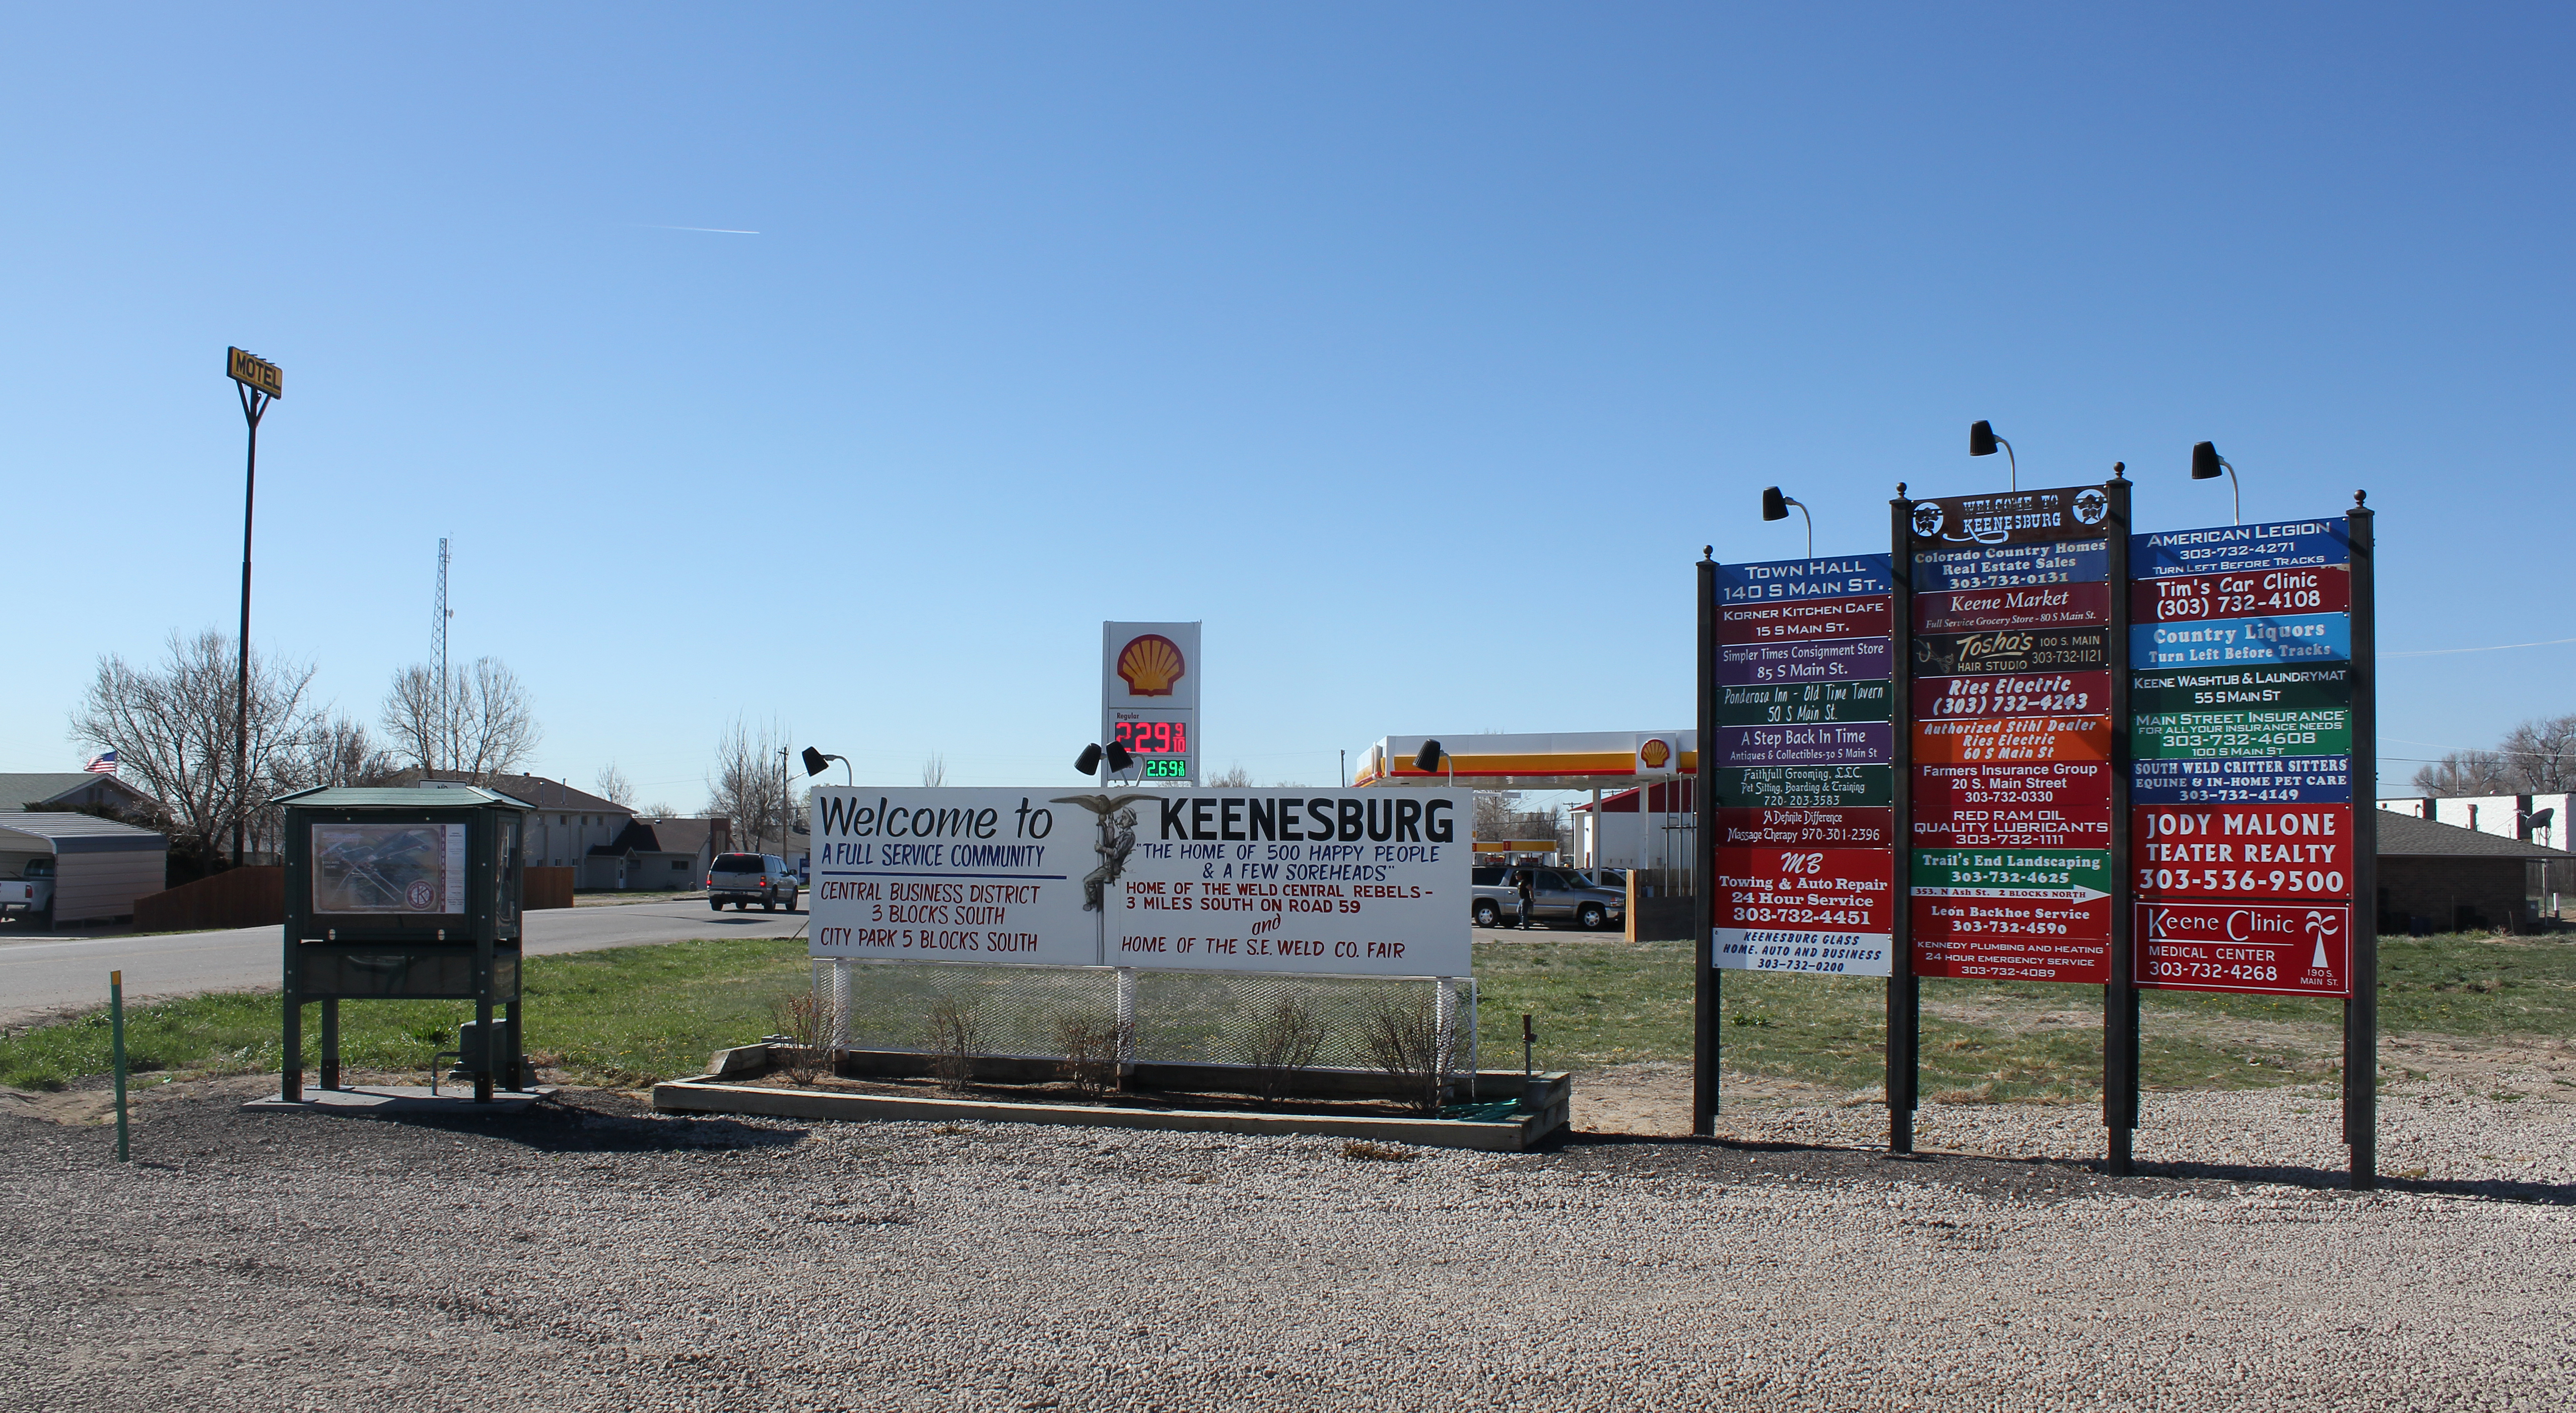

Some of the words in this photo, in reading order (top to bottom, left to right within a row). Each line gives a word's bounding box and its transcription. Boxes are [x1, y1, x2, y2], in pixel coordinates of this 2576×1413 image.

[236, 352, 281, 391] MOTEL
[1962, 496, 2032, 515] WELCOME
[2041, 494, 2059, 509] TO
[1962, 512, 2061, 544] KEENESBURG
[2146, 528, 2250, 548] AMERICAN
[2255, 521, 2331, 539] LEGION
[1915, 549, 1981, 563] Colorado
[1985, 545, 2051, 559] Country
[2055, 541, 2107, 554] Homes
[2180, 542, 2295, 560] 303-732-4271
[1809, 560, 1867, 576] HALL
[1949, 572, 2069, 589] 303-732-0131
[2156, 578, 2210, 597] Tim's
[2219, 577, 2254, 593] Car
[2263, 572, 2318, 590] Clinic
[1950, 595, 2001, 612] Keene
[2005, 589, 2069, 609] Market
[2156, 597, 2209, 620] (303)
[2217, 590, 2321, 613] 732-4108
[1724, 609, 1779, 621] KORNER
[1783, 605, 1842, 618] KITCHEN
[1846, 603, 1884, 613] CAFE
[2153, 627, 2237, 645] Country
[2244, 623, 2326, 642] Liquors
[1723, 648, 1758, 664] Simpler
[1760, 648, 1789, 660] Times
[1791, 644, 1855, 660] Consignment
[1857, 643, 1884, 655] Store
[1956, 631, 2033, 662] Tosha's
[2031, 649, 2102, 664] 303-732-1121
[1957, 661, 1982, 672] HAIR
[1985, 660, 2027, 671] STUDIO
[1948, 679, 1990, 696] Ries
[1994, 676, 2071, 695] Electric
[2134, 677, 2175, 689] KEENE
[2177, 674, 2240, 687] WASHTUB
[2242, 672, 2253, 684] &
[2255, 670, 2346, 684] LAUNDRYMAT
[1933, 696, 1987, 716] (303)
[1992, 692, 2088, 713] 732-4243
[1116, 712, 1139, 721] Regular
[2162, 732, 2316, 747] 303-732-4608
[1730, 751, 1766, 762] Antiques
[1768, 750, 1774, 759] &
[1776, 748, 1836, 760] Collectibles-30
[1838, 749, 1843, 758] S
[1846, 748, 1866, 758] Main
[1868, 747, 1877, 757] St
[1146, 760, 1178, 777] 2.69
[1743, 768, 1783, 782] Faithfull
[1923, 765, 1978, 776] Farmers
[1982, 764, 2049, 776] Insurance
[2053, 763, 2097, 777] Group
[1964, 791, 2053, 803] 303-732-0330
[2180, 789, 2299, 801] 303-732-4149
[820, 796, 998, 839] Welcome
[1014, 797, 1053, 839] to
[1161, 798, 1453, 843] KEENESBURG
[2146, 813, 2212, 839] JODY
[2223, 813, 2336, 835] MALONE
[1727, 827, 1762, 842] Massage
[1763, 828, 1798, 843] Therapy
[1801, 828, 1880, 841] 970-301-2396
[1955, 834, 2064, 845] 303-732-1111
[822, 843, 832, 865] A
[836, 843, 872, 865] FULL
[882, 843, 943, 867] SERVICE
[951, 844, 1046, 867] COMMUNITY
[1180, 843, 1226, 860] HOME
[1237, 844, 1256, 860] OF
[1267, 845, 1301, 861] 500
[1310, 845, 1364, 861] HAPPY
[1375, 845, 1440, 863] PEOPLE
[2145, 843, 2234, 862] TEATER
[2244, 844, 2336, 863] REALTY
[1202, 863, 1214, 879] &
[1223, 864, 1233, 879] A
[1241, 864, 1277, 880] FEW
[1780, 852, 1823, 874] MB
[1719, 875, 1774, 891] Towing
[1778, 877, 1792, 890] &
[1796, 877, 1833, 890] Auto
[1835, 878, 1888, 893] Repair
[1951, 871, 2070, 884] 303-732-4625
[2139, 869, 2344, 892] 303-536-9500
[417, 885, 428, 905] K
[821, 881, 883, 901] CENTRAL
[890, 883, 963, 903] BUSINESS
[970, 884, 1041, 904] DISTRICT
[1126, 882, 1166, 895] HOME
[1174, 882, 1194, 895] OF
[1204, 883, 1232, 896] THE
[1238, 883, 1278, 896] WELD
[1282, 884, 1343, 898] CENTRAL
[1126, 897, 1135, 909] 3
[1143, 897, 1192, 910] MILES
[1200, 897, 1254, 911] SOUTH
[1260, 898, 1283, 912] ON
[1289, 899, 1332, 913] ROAD
[1339, 900, 1361, 913] 59
[871, 905, 883, 923] 3
[889, 905, 948, 925] BLOCKS
[954, 906, 1005, 925] SOUTH
[1251, 913, 1281, 935] and
[1733, 907, 1871, 925] 303-732-4451
[1952, 920, 2067, 935] 303-732-4590
[2148, 908, 2219, 938] Keene
[2226, 909, 2294, 941] Clinic
[821, 928, 852, 946] CITY
[858, 928, 898, 948] PARK
[902, 930, 913, 948] 5
[920, 930, 979, 951] BLOCKS
[987, 932, 1038, 952] SOUTH
[1122, 936, 1167, 953] HOME
[1177, 937, 1196, 954] OF
[1205, 938, 1239, 955] THE
[1247, 939, 1273, 956] S.E.
[1277, 940, 1325, 957] WELD
[1335, 941, 1360, 958] CO.
[1367, 942, 1405, 959] FAIR
[1743, 932, 1818, 944] KEENESBURG
[1822, 935, 1860, 946] GLASS
[1917, 941, 1968, 949] KENNEDY
[1970, 943, 2025, 952] PLUMBING
[2027, 945, 2052, 953] AND
[2054, 946, 2104, 954] HEATING
[2149, 946, 2208, 959] MEDICAL
[2215, 948, 2275, 962] CENTER
[1757, 958, 1844, 972] 303-732-0200
[1961, 966, 2056, 977] 303-732-4089
[2149, 961, 2277, 981] 303-732-4268
[2307, 968, 2326, 977] 190
[2326, 969, 2334, 978] S.
[2300, 977, 2323, 985] MAIN
[2327, 978, 2339, 986] ST.
